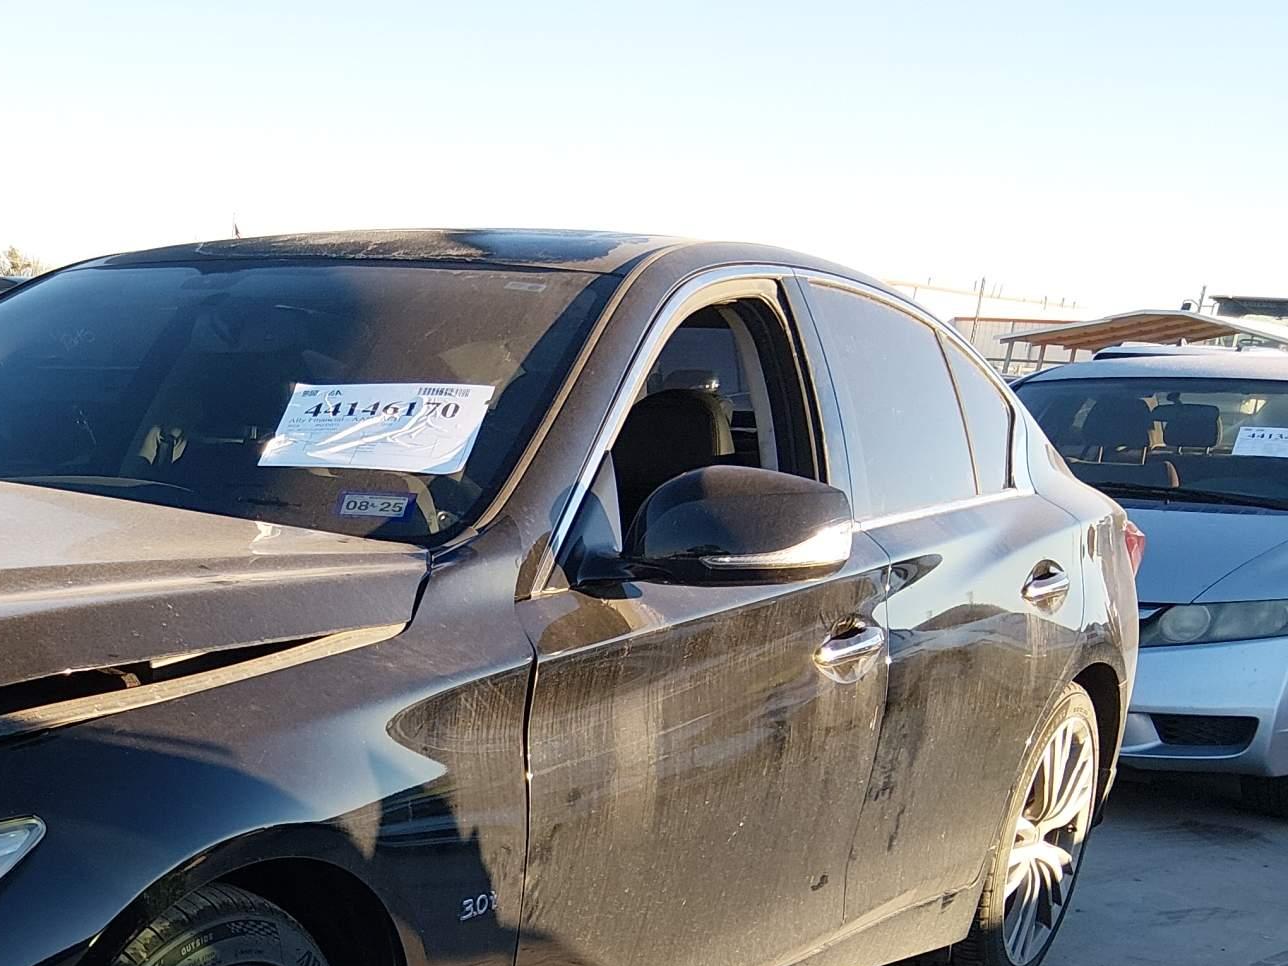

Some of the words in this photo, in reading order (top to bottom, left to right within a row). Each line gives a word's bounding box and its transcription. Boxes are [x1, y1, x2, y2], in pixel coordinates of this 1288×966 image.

[303, 400, 461, 419] 44146170
[345, 500, 370, 511] 08
[379, 501, 404, 513] 25
